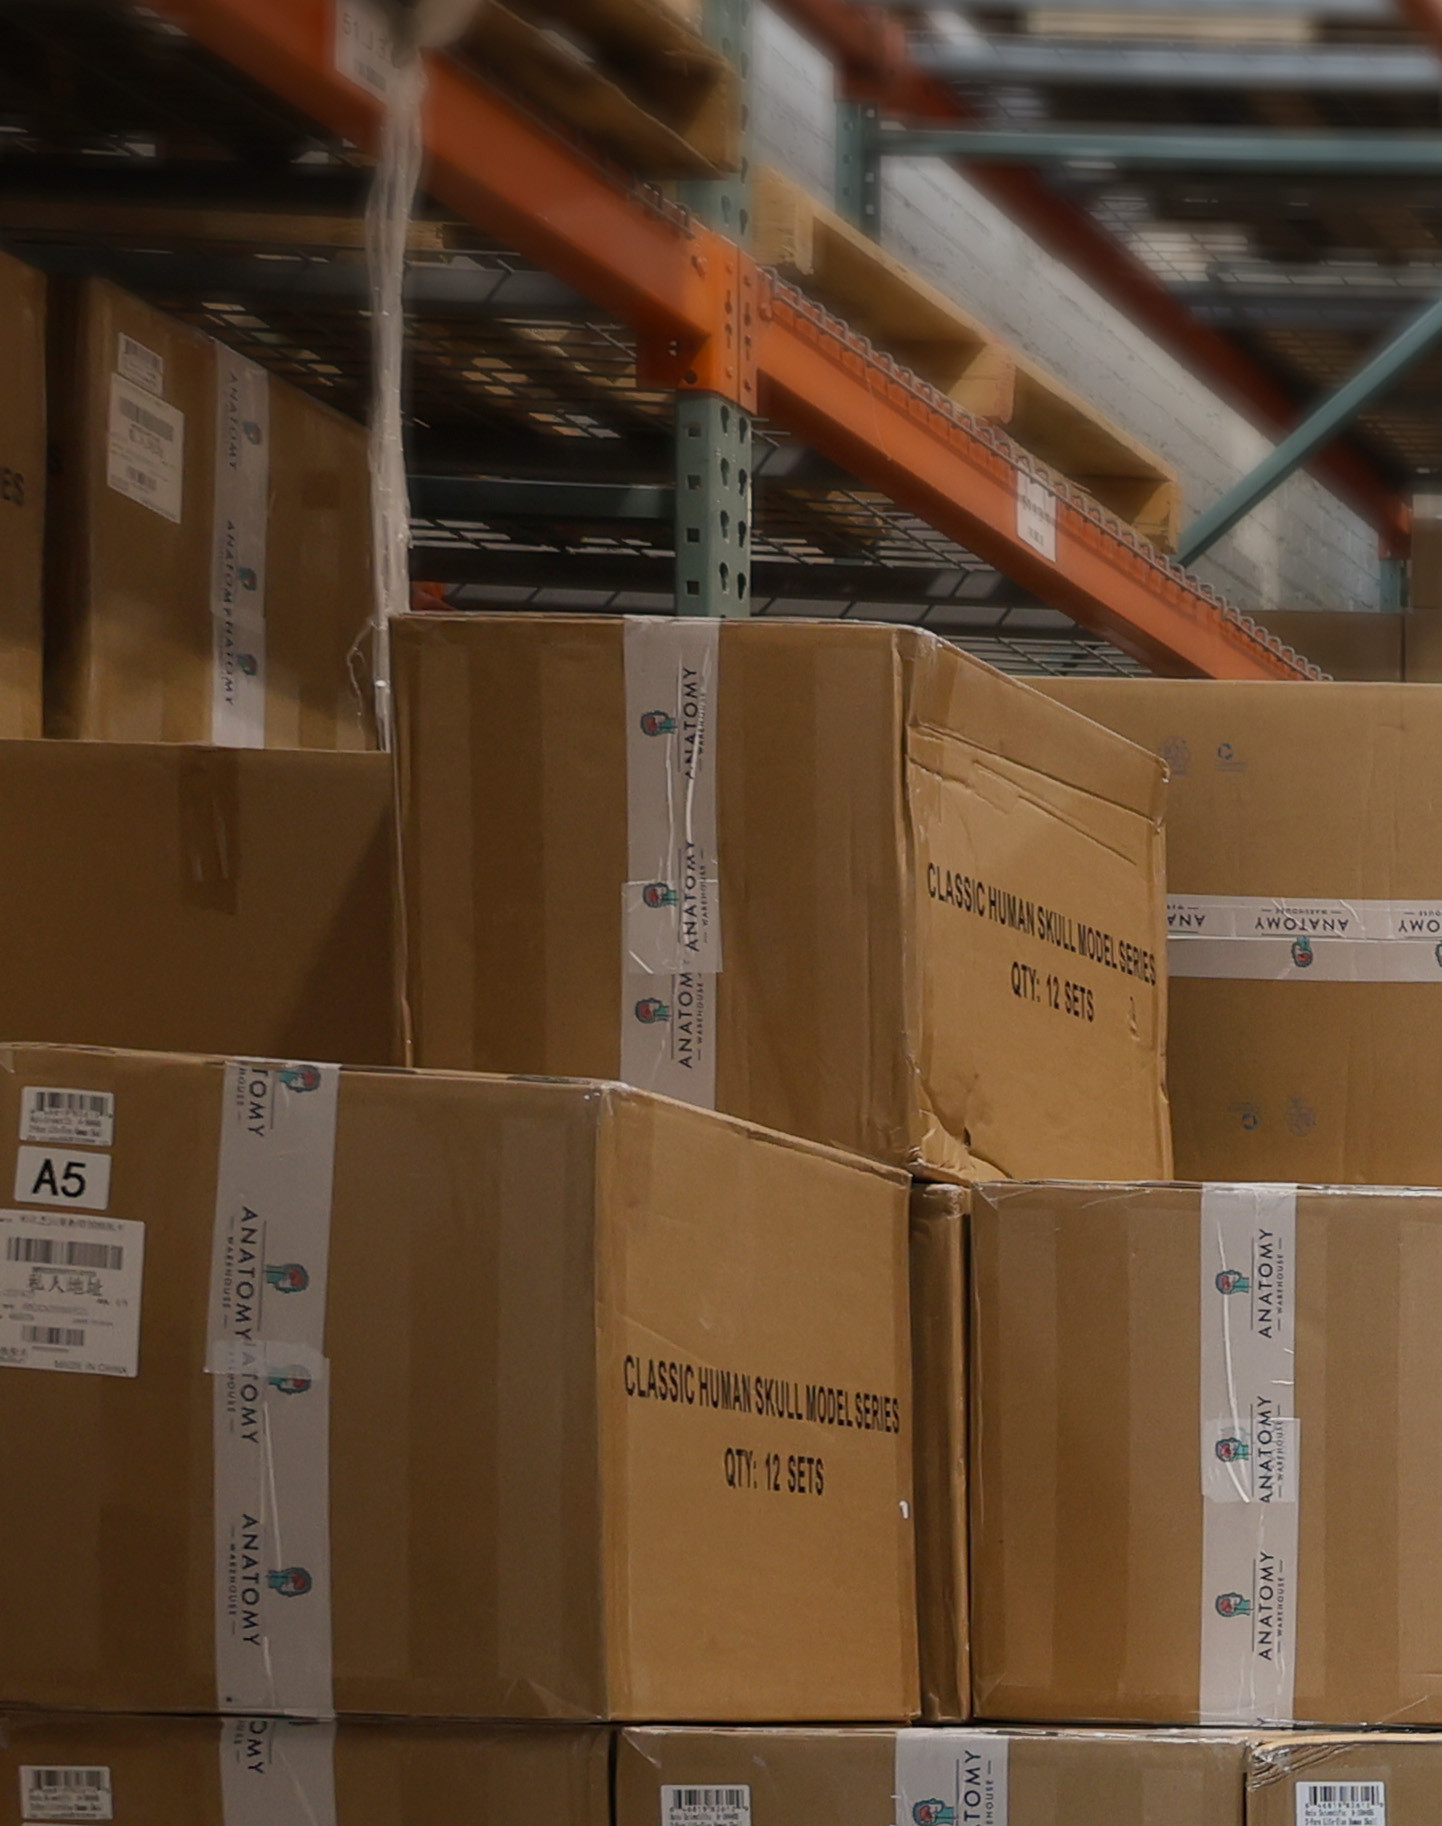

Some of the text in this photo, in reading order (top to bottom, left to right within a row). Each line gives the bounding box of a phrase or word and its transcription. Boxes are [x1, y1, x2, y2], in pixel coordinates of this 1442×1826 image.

[927, 862, 1156, 986] CLASSIC HUMAN SKULL MODEL SERIES
[1255, 916, 1349, 932] ANATOMY
[678, 972, 693, 1069] ANATOM
[1011, 961, 1094, 1023] QTY: 12 SETS
[32, 1158, 87, 1198] A5
[234, 1205, 258, 1347] ANATOMY
[1258, 1228, 1273, 1340] ANATOMY
[624, 1354, 900, 1434] CLASSIC HUMAN SKULL MODEL SERIES
[724, 1447, 824, 1496] QTY: 12 SETS
[1256, 1395, 1272, 1504] ANATOMY
[229, 1544, 238, 1616] WAREHOUSE
[241, 1513, 260, 1646] ANATOMY
[1258, 1551, 1274, 1662] ANATOMY
[1276, 1576, 1284, 1638] WAREHOUSE
